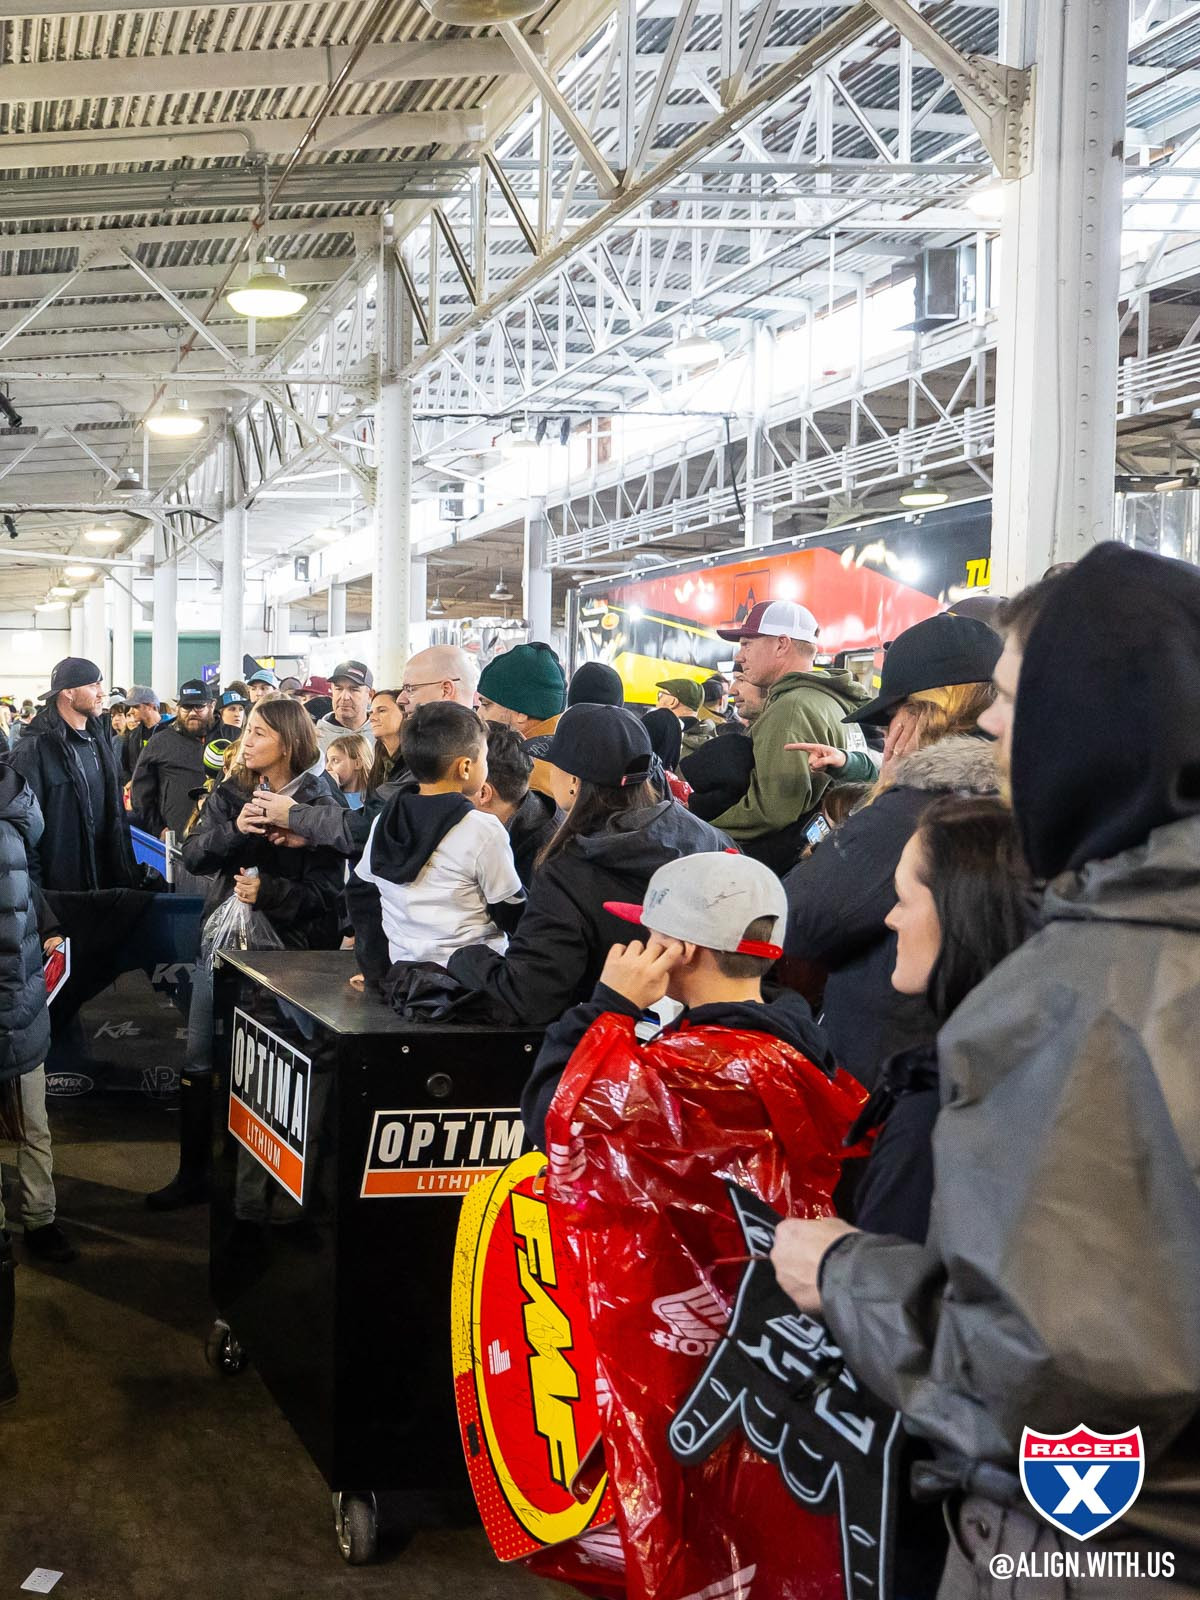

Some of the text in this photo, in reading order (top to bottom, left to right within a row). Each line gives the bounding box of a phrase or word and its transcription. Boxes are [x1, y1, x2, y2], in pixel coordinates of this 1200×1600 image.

[234, 1027, 304, 1142] OPTIMA
[245, 1117, 281, 1170] LITHIUM
[377, 1120, 530, 1163] OPTIM
[417, 1174, 487, 1190] LITHI
[511, 1192, 580, 1490] FMF
